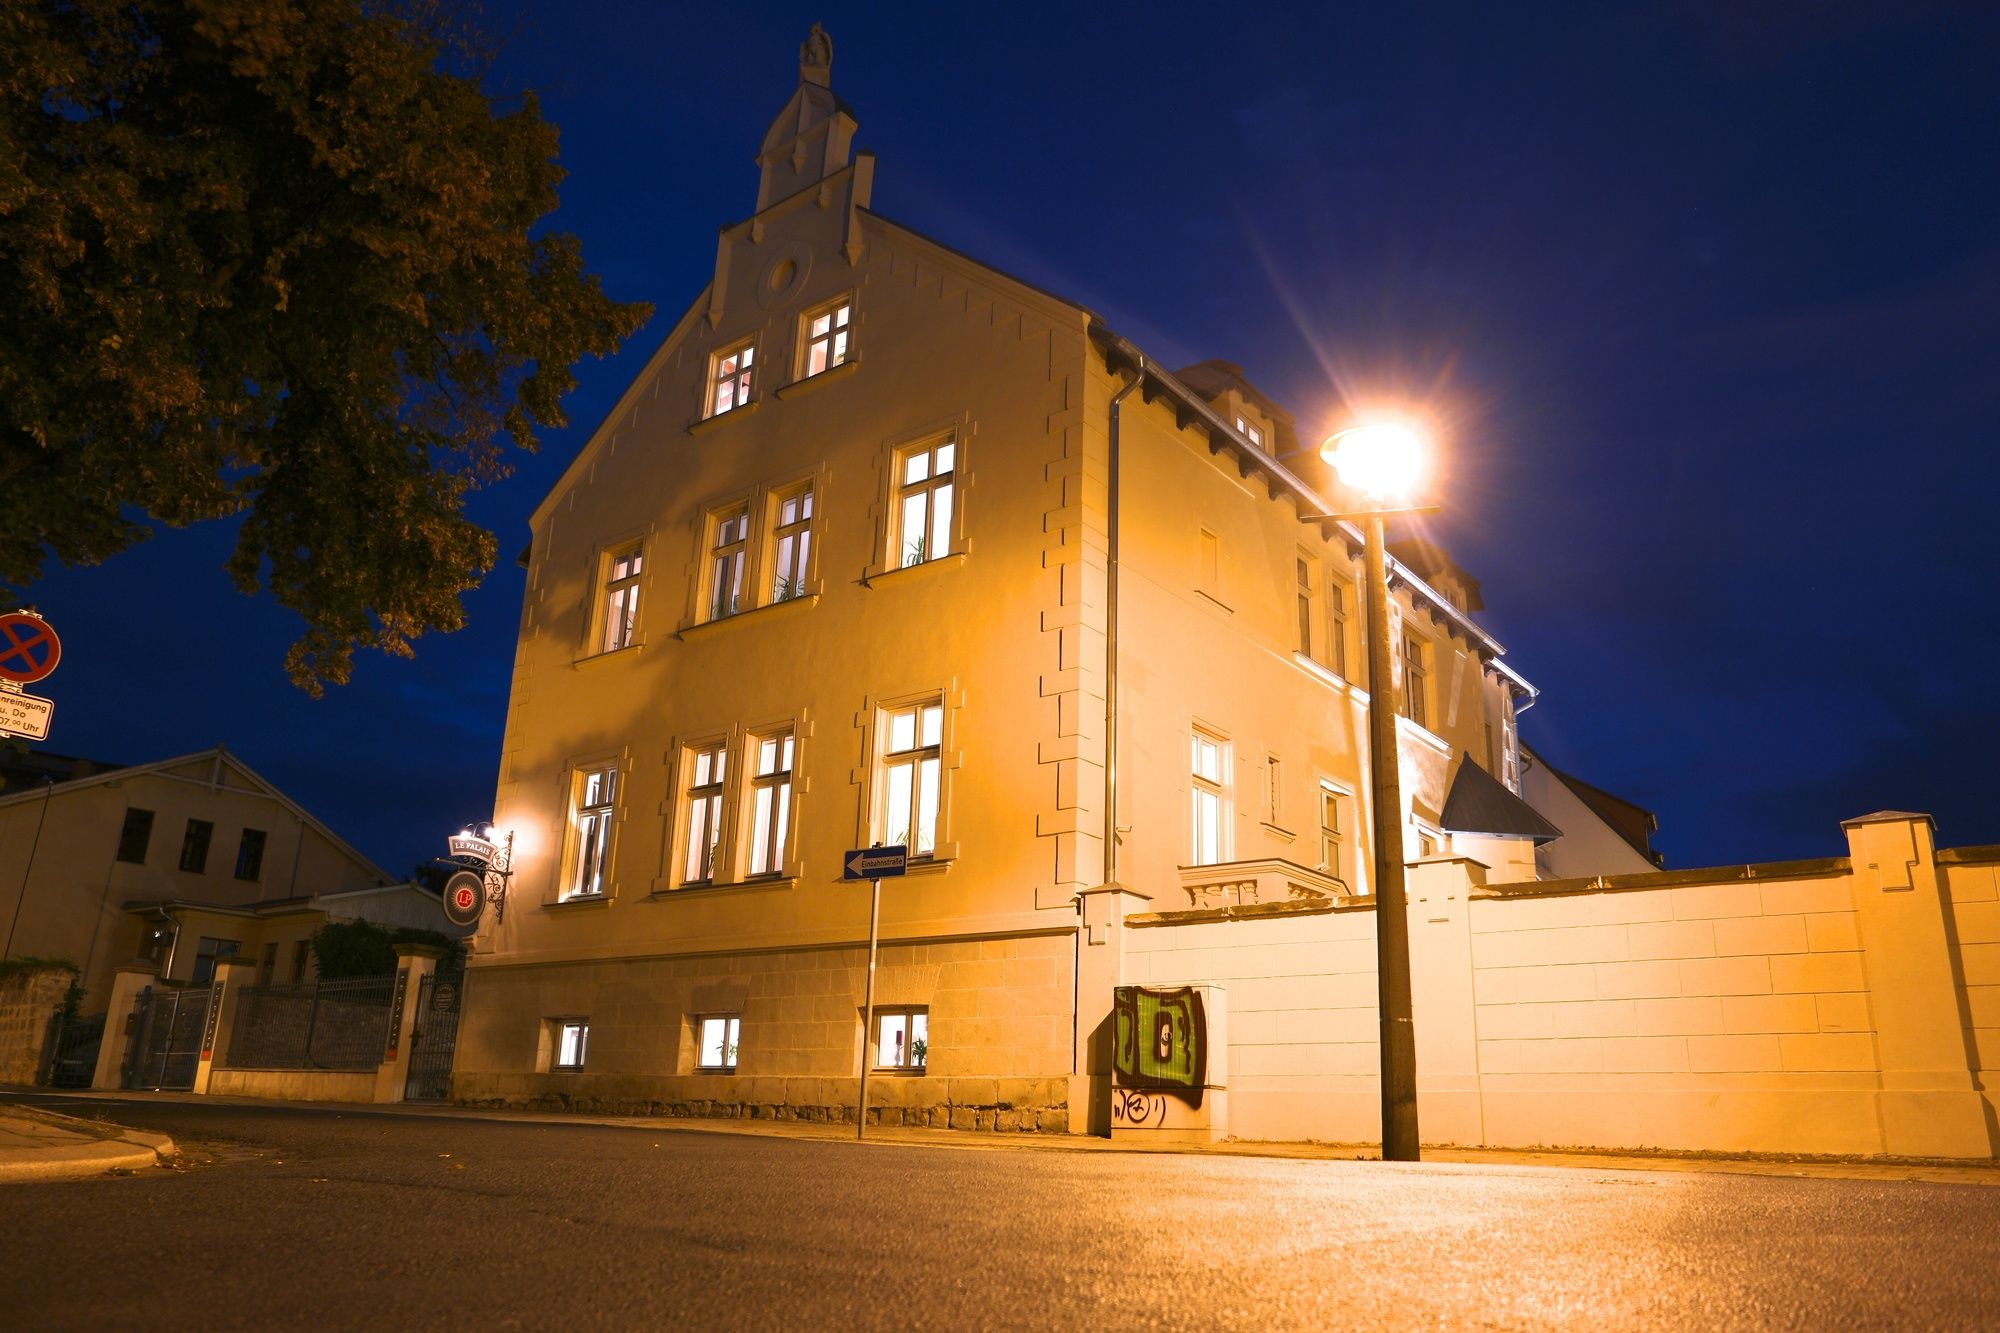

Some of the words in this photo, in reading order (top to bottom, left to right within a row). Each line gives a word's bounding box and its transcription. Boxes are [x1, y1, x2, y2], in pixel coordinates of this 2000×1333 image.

[0, 696, 47, 713] nreinigung
[12, 709, 26, 718] Do
[23, 722, 39, 732] Uhr
[466, 842, 491, 855] PALAIS
[862, 857, 903, 868] Einbahnstraße
[459, 893, 472, 904] LP
